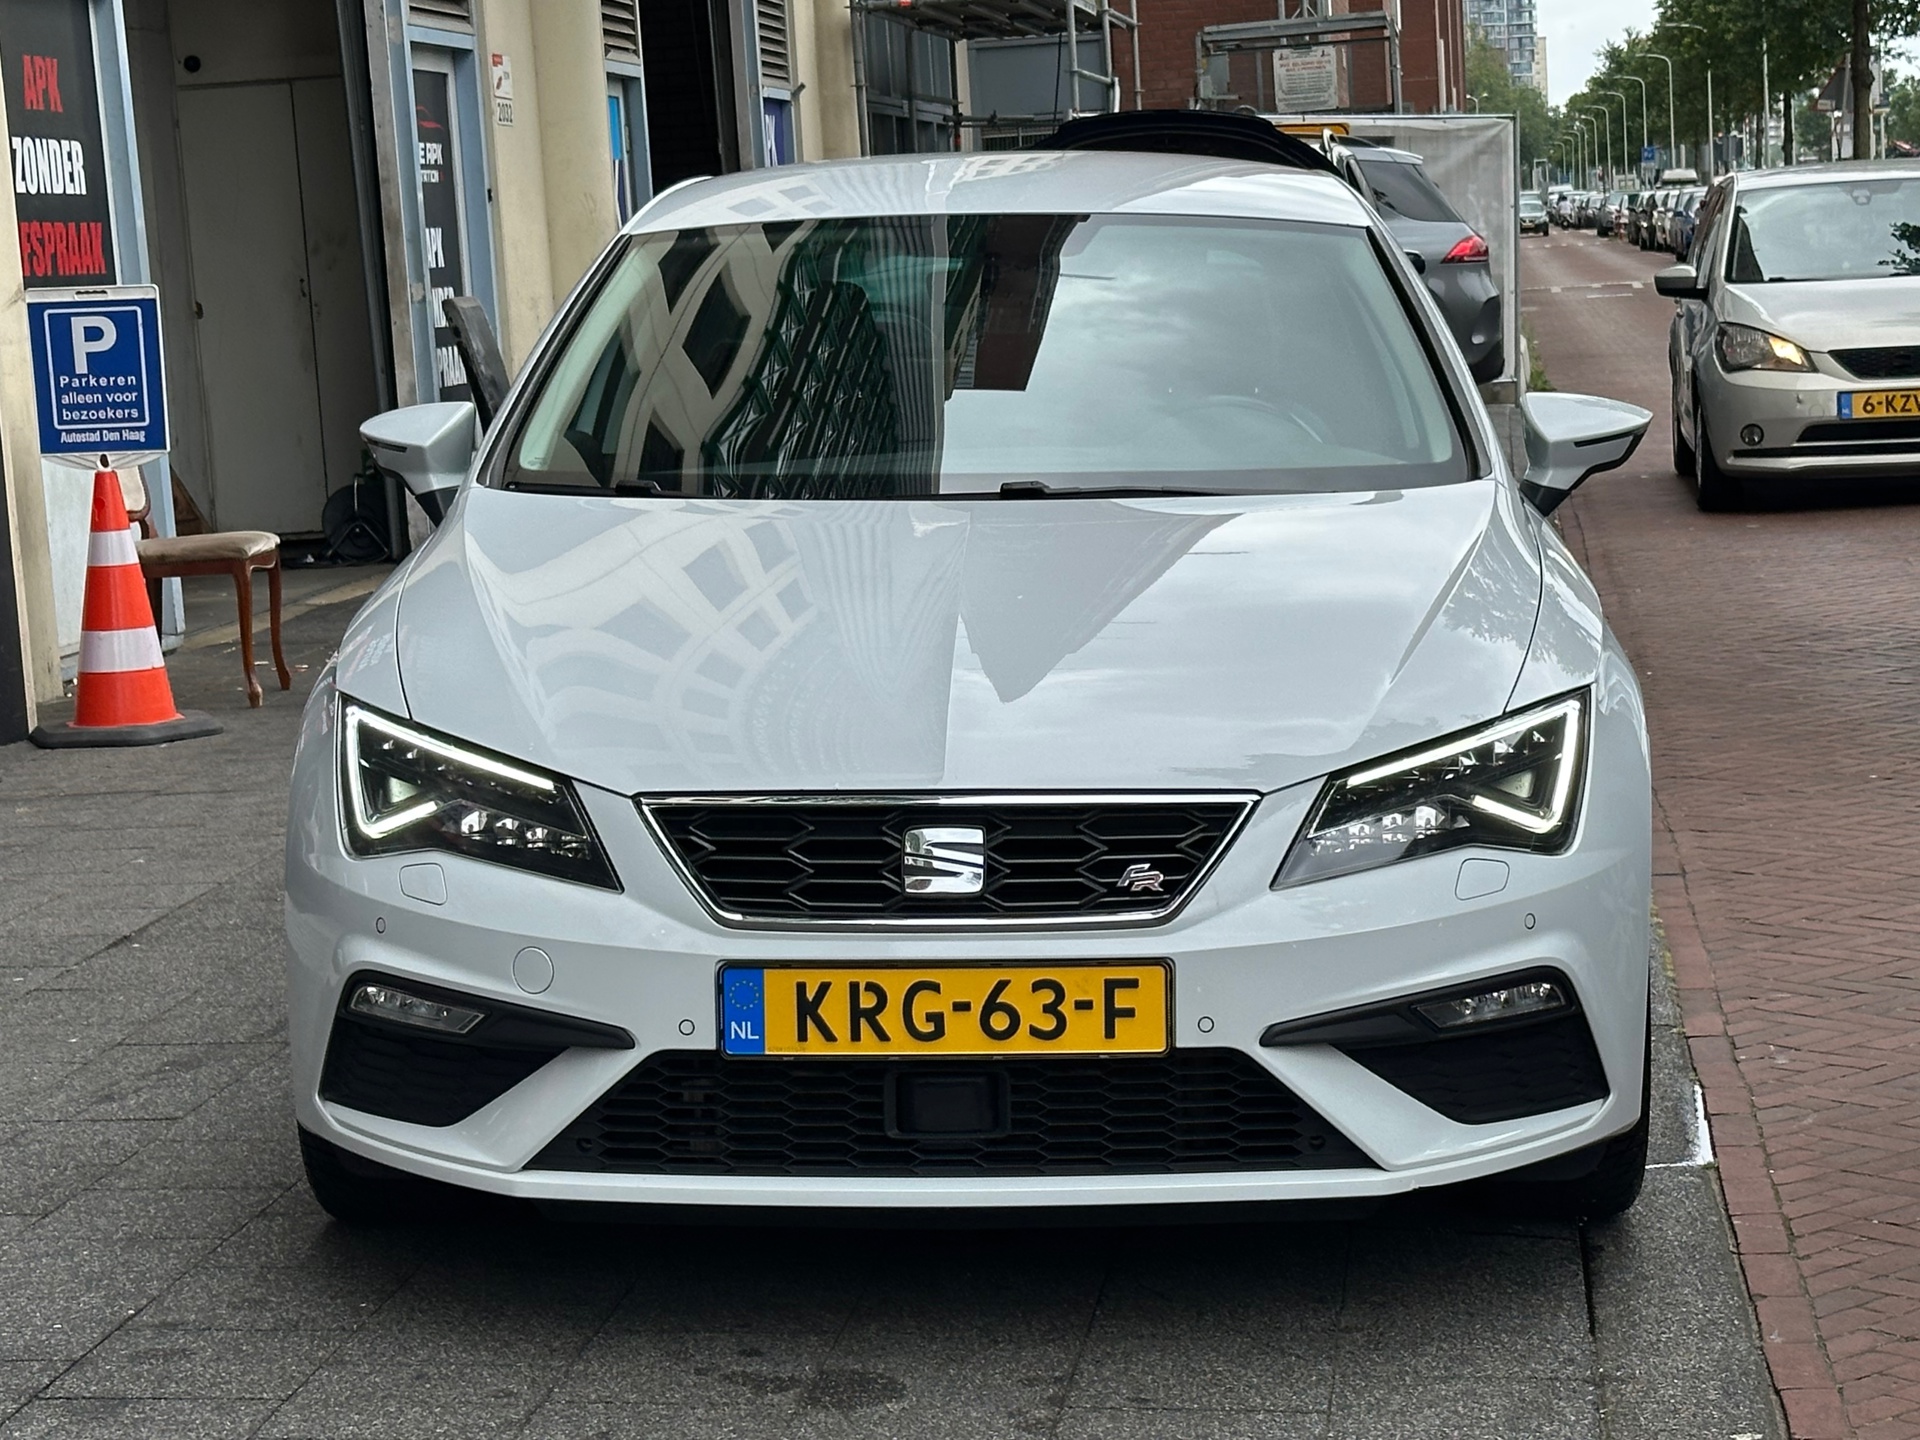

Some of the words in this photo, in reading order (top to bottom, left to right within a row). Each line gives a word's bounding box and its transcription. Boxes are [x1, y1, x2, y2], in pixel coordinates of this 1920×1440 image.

[22, 54, 63, 113] APK
[11, 136, 87, 195] ZONDER
[70, 315, 117, 375] P
[59, 374, 137, 388] Parkeren
[61, 391, 102, 404] alleen
[105, 392, 138, 402] voor
[62, 406, 139, 420] bezoekers
[60, 430, 100, 443] Autostad
[102, 430, 120, 441] Den
[122, 429, 146, 442] Haag
[794, 977, 1140, 1043] KRG-63-F
[730, 1021, 759, 1040] NL
